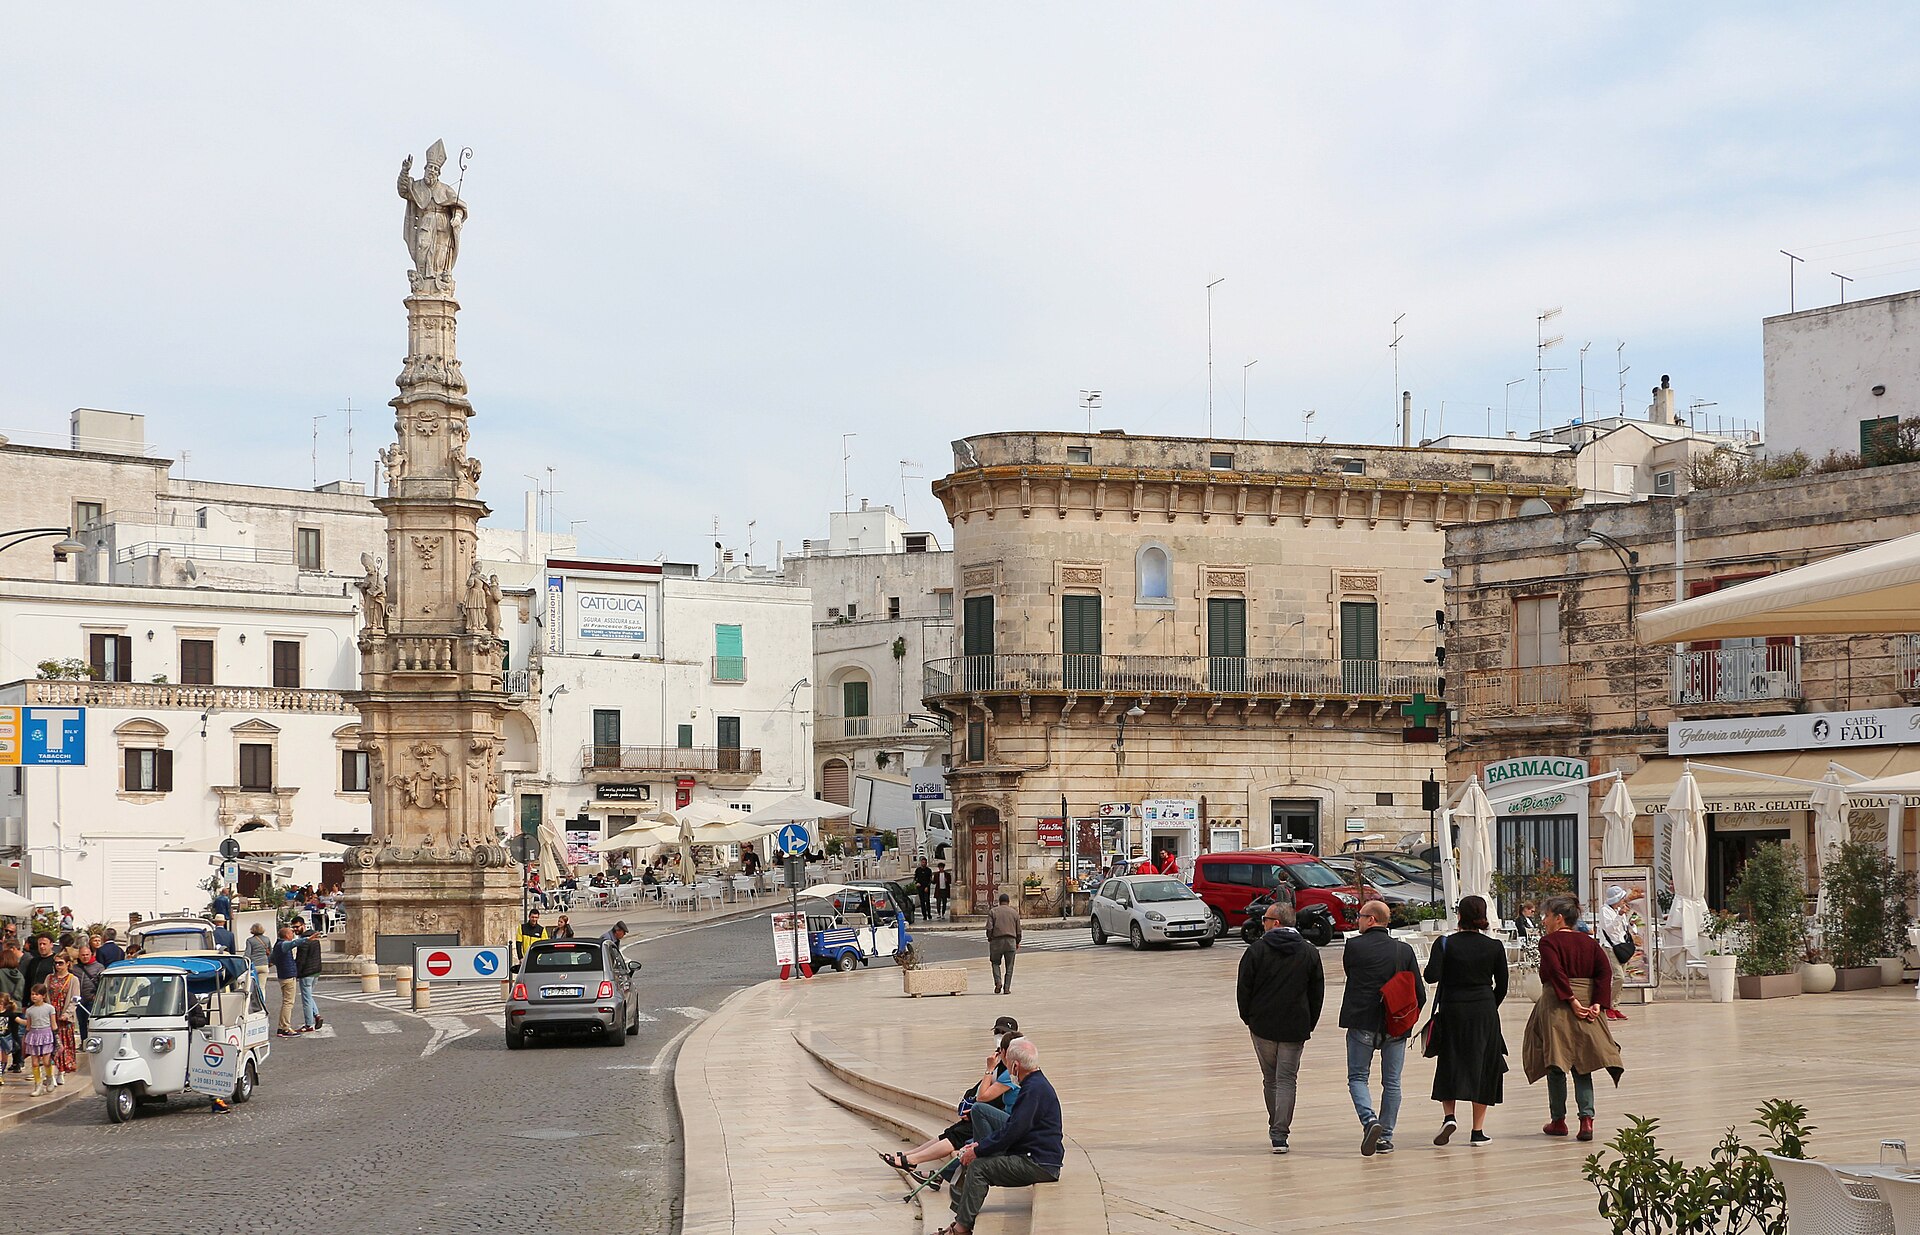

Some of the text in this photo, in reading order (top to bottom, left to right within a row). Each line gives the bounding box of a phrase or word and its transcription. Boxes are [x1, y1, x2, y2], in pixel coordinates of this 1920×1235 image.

[580, 596, 644, 612] CATTOLICA
[1845, 714, 1878, 726] CAFFÈ
[30, 709, 79, 749] T
[1678, 724, 1885, 748] Gelateria artigianale FADI
[1486, 760, 1584, 784] FARMACIA
[914, 784, 941, 792] fanelli
[1508, 794, 1564, 813] in Piazza
[1734, 802, 1756, 811] BAR
